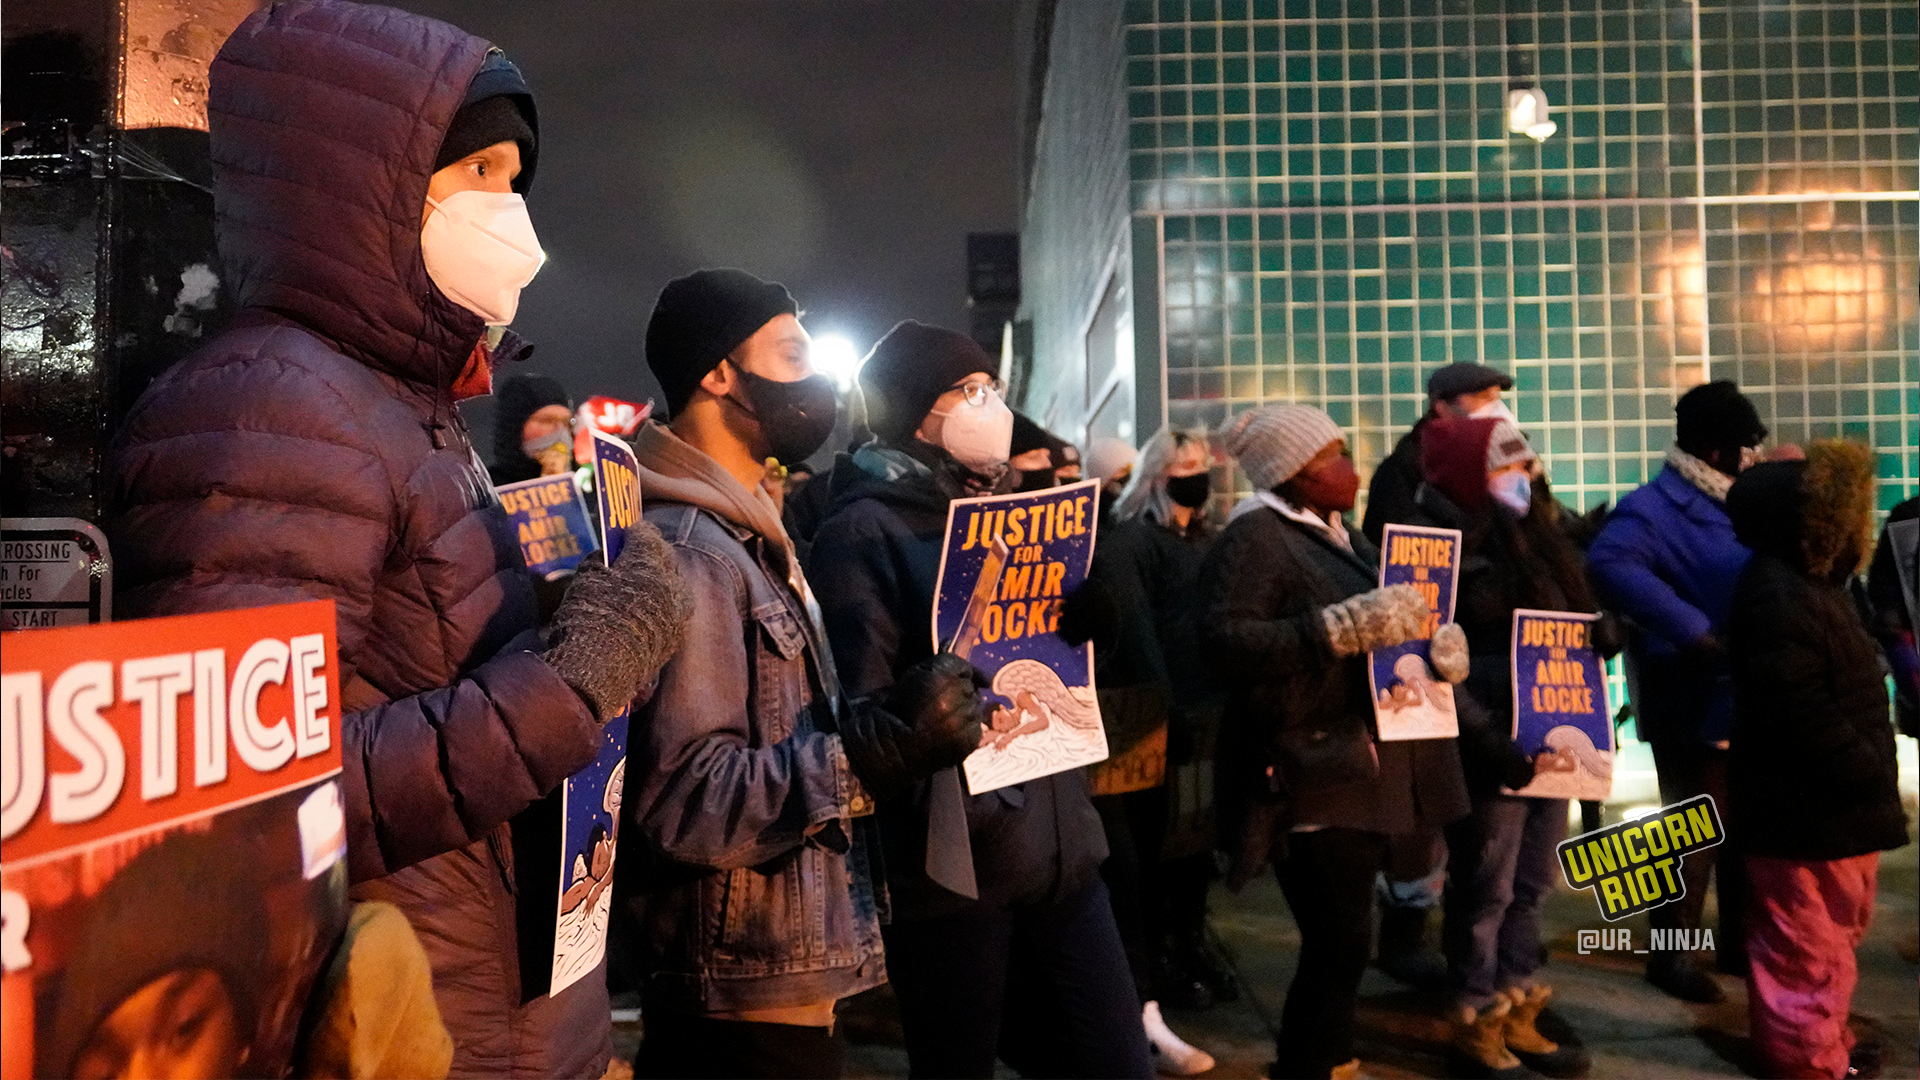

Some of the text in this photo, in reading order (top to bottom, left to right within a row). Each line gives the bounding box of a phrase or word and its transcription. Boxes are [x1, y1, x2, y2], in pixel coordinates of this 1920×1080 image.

[500, 481, 572, 515] USTICE
[961, 495, 1090, 551] JUSTICE
[1, 543, 70, 559] ROSSING
[1013, 545, 1043, 564] FOR
[1389, 535, 1453, 568] JUSTICE
[19, 565, 41, 581] For
[990, 561, 1066, 602] MIR
[1, 584, 32, 600] icles
[12, 609, 58, 627] START
[974, 599, 1065, 645] OCK
[1535, 659, 1586, 686] AMIR
[1531, 685, 1595, 714] LOCKE
[1, 634, 331, 840] USTICE
